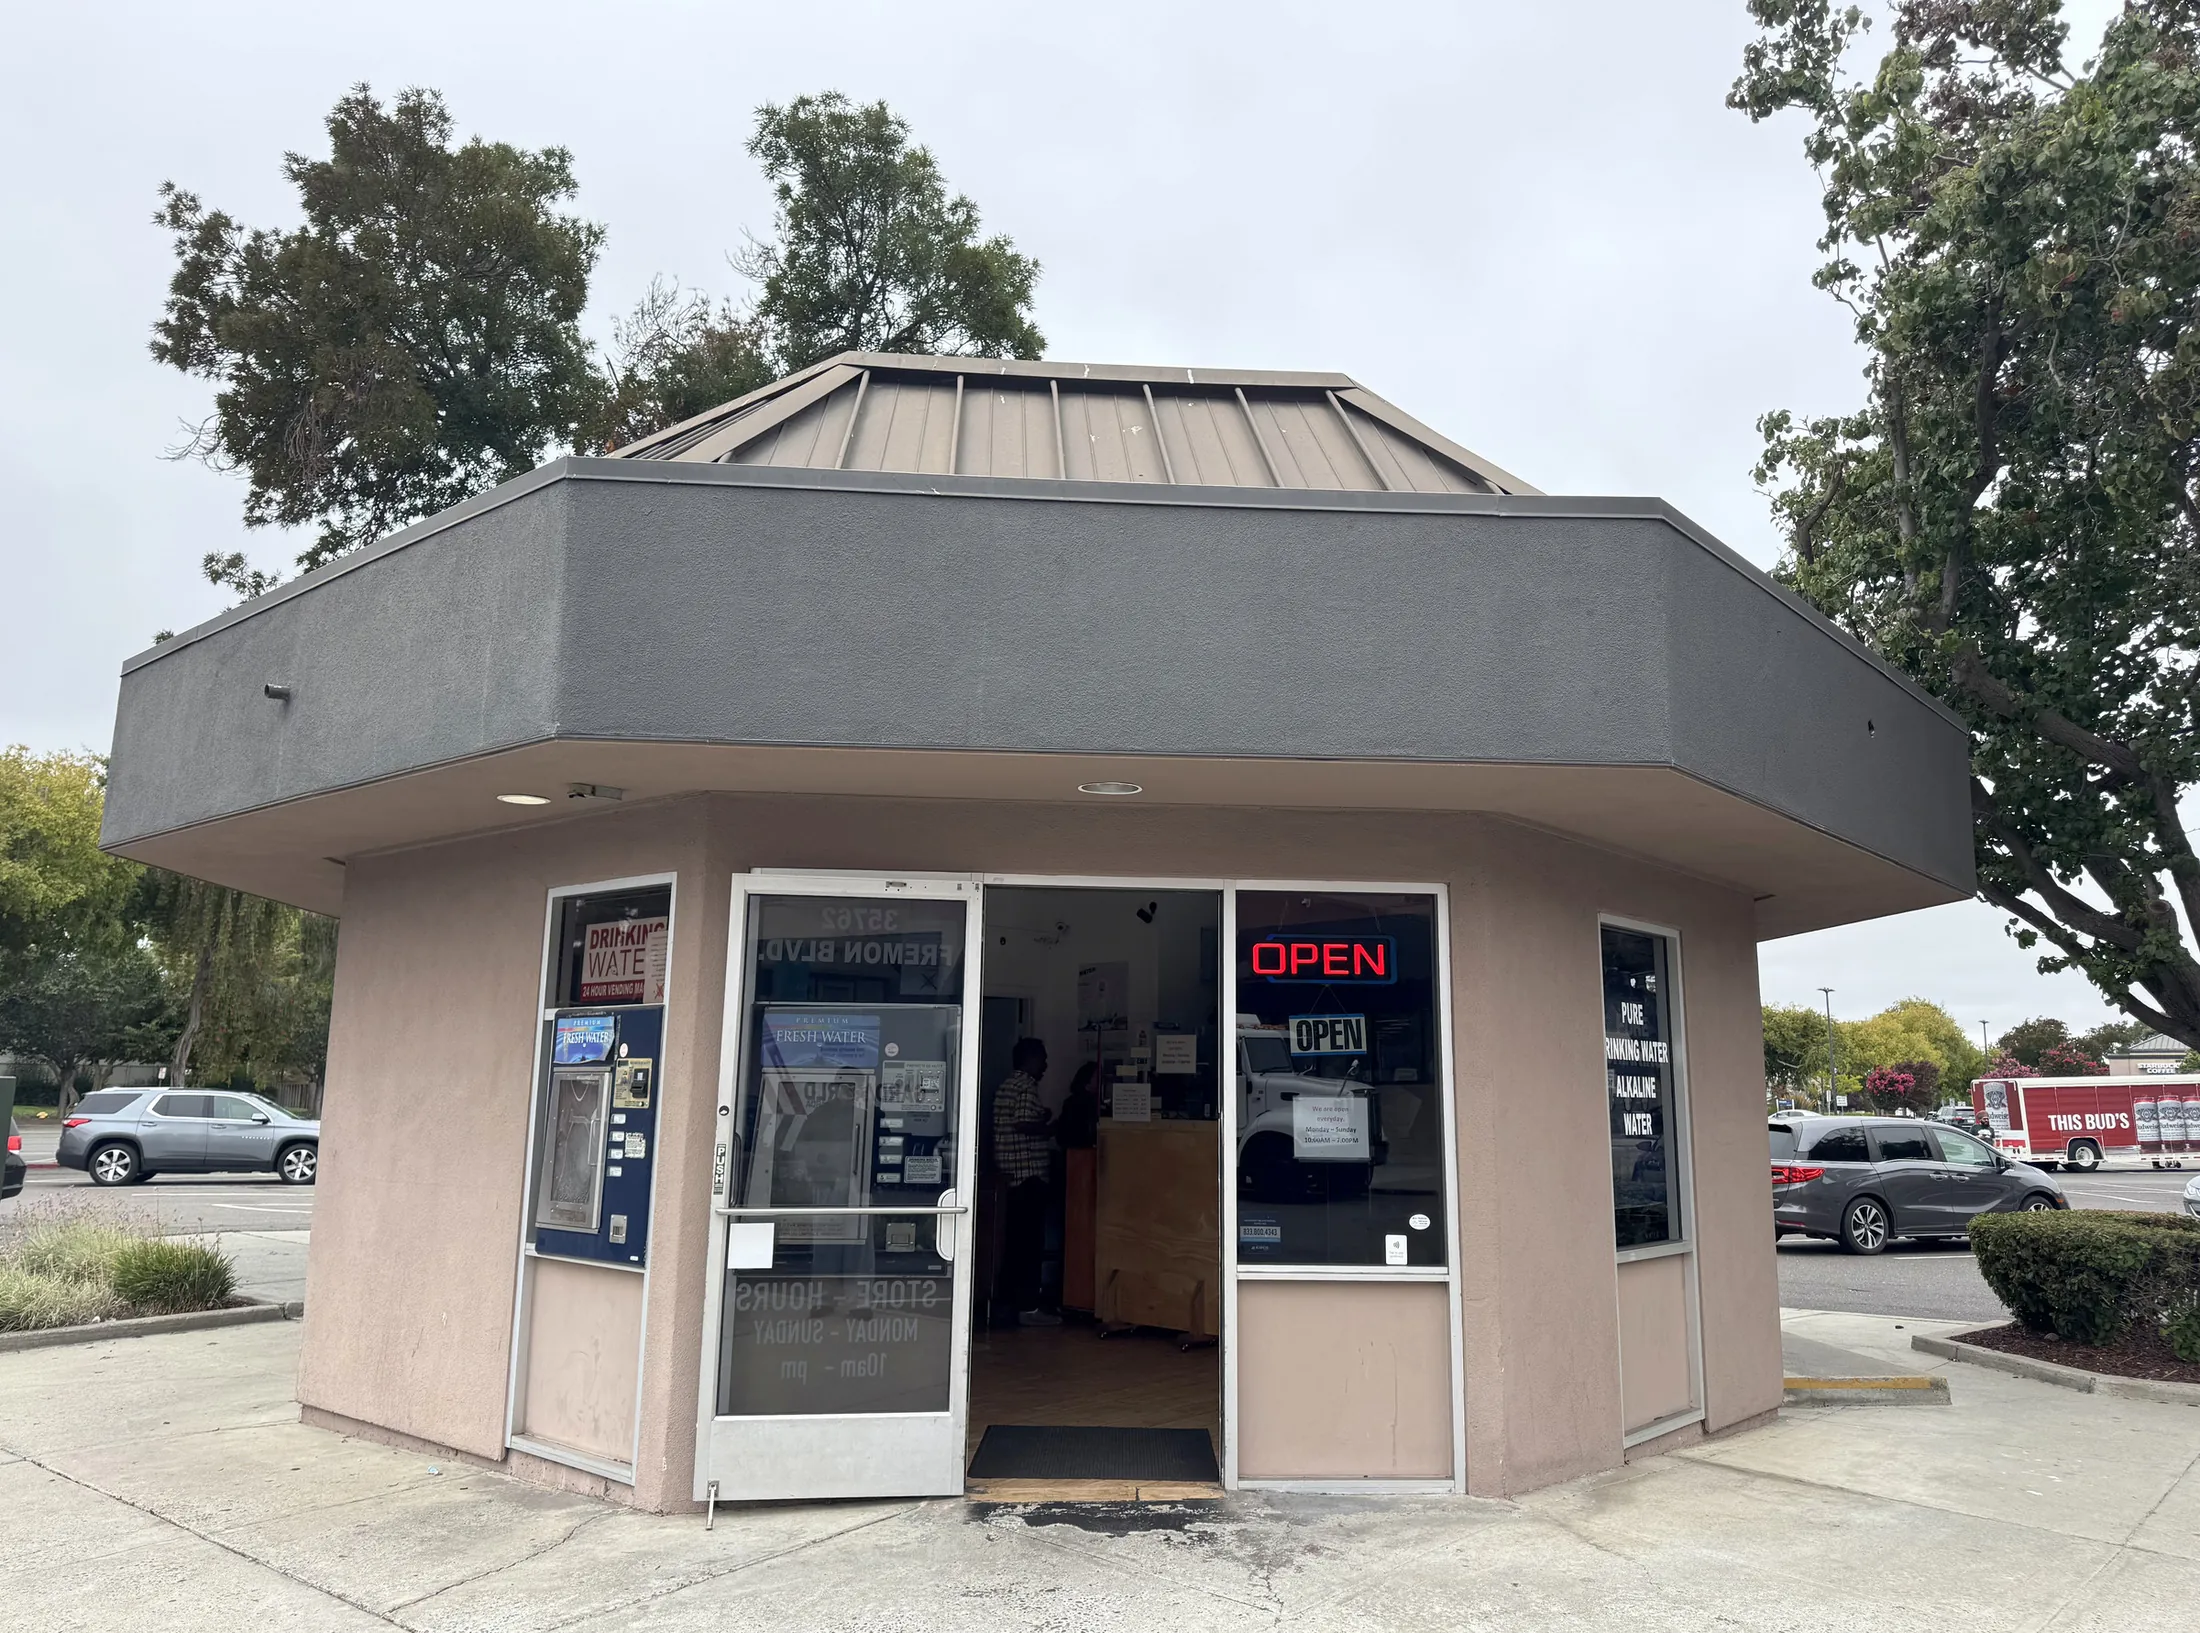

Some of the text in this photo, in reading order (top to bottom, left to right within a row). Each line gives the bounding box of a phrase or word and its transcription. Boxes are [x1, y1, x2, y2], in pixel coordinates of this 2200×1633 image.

[589, 948, 646, 978] WATE
[1252, 942, 1385, 976] OPEN
[582, 986, 590, 996] 24
[590, 984, 607, 996] HOUR
[608, 982, 634, 996] VENDING
[1621, 1002, 1644, 1025] PURE
[563, 1031, 609, 1044] FRESH WATER
[776, 1030, 866, 1044] FRESH WATER
[1296, 1018, 1362, 1052] OPEN
[1606, 1038, 1668, 1063] RINKING WATER
[1616, 1076, 1656, 1098] ALKALINE
[1624, 1113, 1652, 1136] WATER
[2048, 1112, 2130, 1131] THIS BUD'S
[715, 1147, 725, 1183] PUSH
